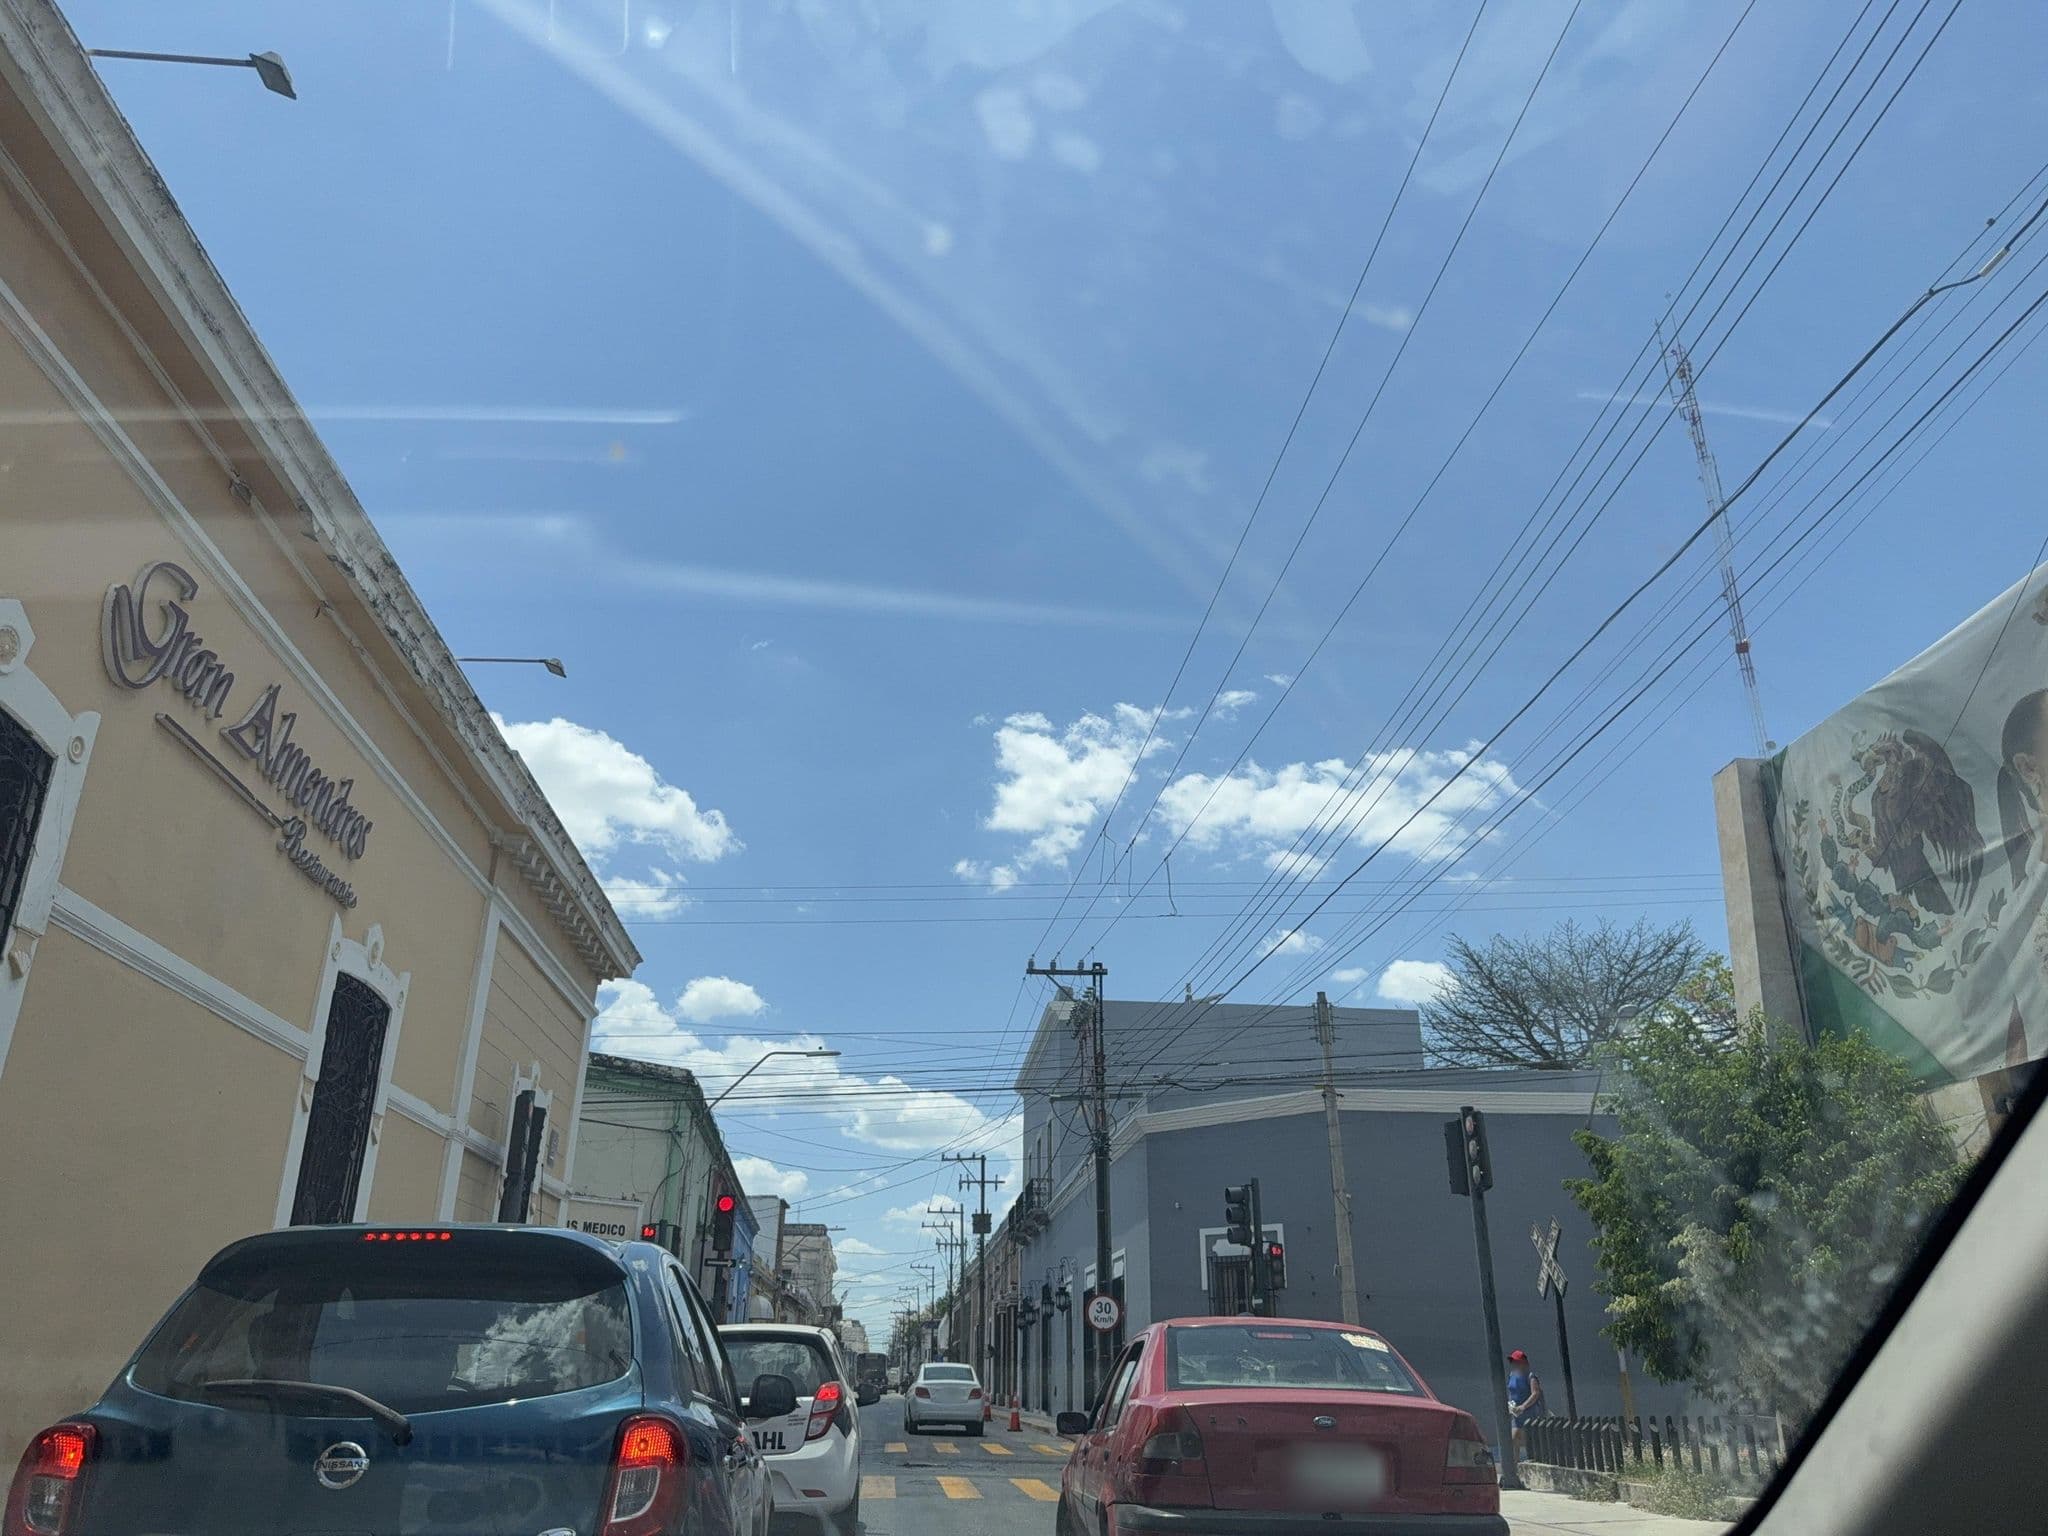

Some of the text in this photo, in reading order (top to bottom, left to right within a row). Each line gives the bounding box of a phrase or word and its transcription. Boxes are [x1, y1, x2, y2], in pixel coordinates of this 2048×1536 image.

[102, 561, 373, 859] Gran Almendros
[583, 1221, 626, 1236] MEDICO
[1095, 1301, 1112, 1314] 30
[320, 1460, 363, 1469] NISSAN
